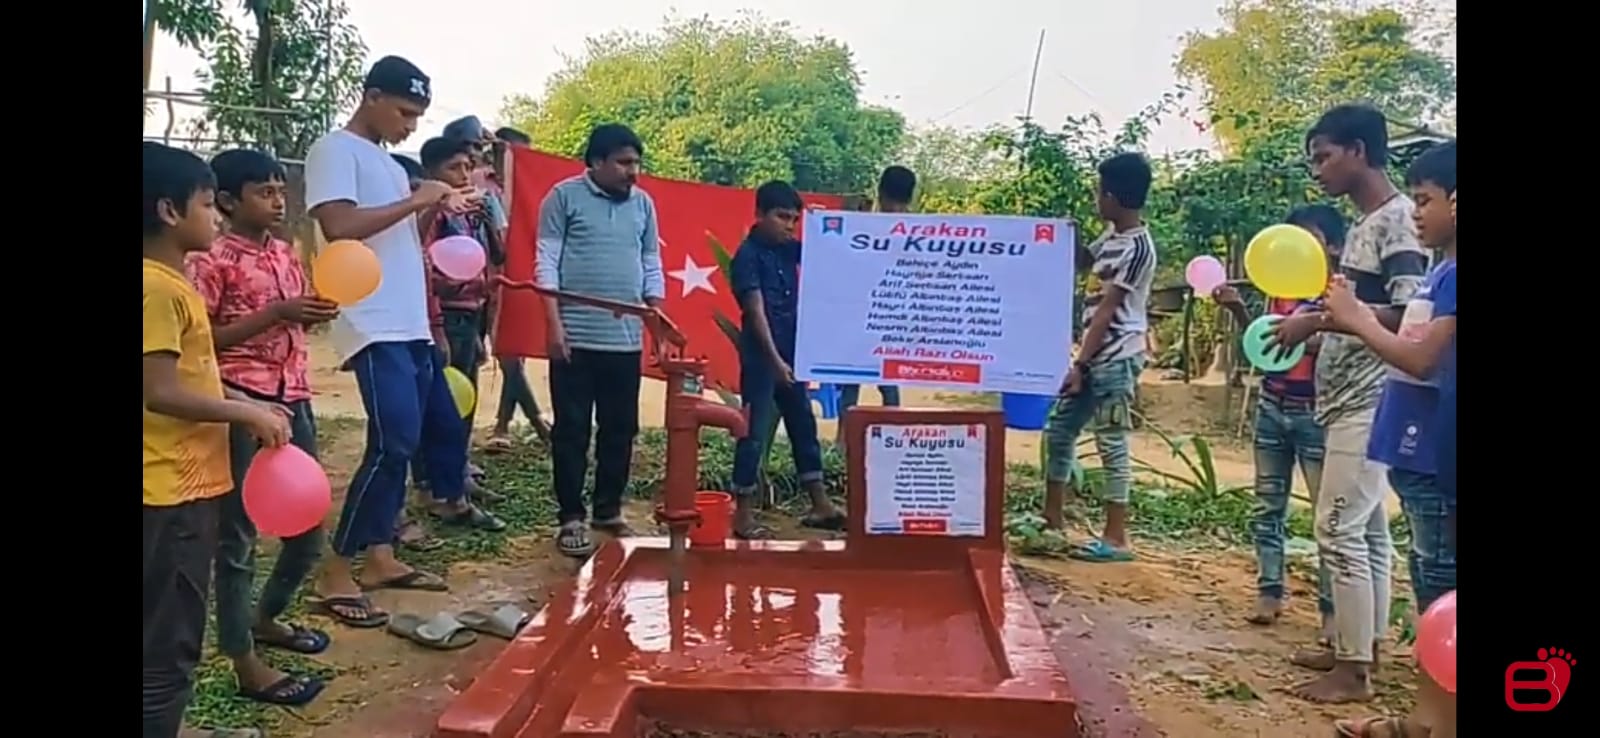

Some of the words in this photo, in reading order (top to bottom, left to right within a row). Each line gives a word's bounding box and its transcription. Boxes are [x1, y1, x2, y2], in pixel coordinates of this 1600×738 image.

[890, 220, 987, 238] Arakan
[850, 234, 889, 251] Su
[903, 236, 1027, 258] Kuyusu
[879, 279, 903, 289] Arif
[959, 283, 996, 292] Ailesi
[965, 294, 1001, 304] Ailesi
[964, 304, 1000, 314] Ailesi
[967, 316, 1002, 327] Ailesi
[967, 327, 1002, 337] Ailesi
[872, 346, 911, 356] Allah
[950, 349, 995, 361] Olsun
[901, 427, 947, 438] Arakan
[884, 436, 903, 448] Su
[909, 438, 966, 451] Kuyusu
